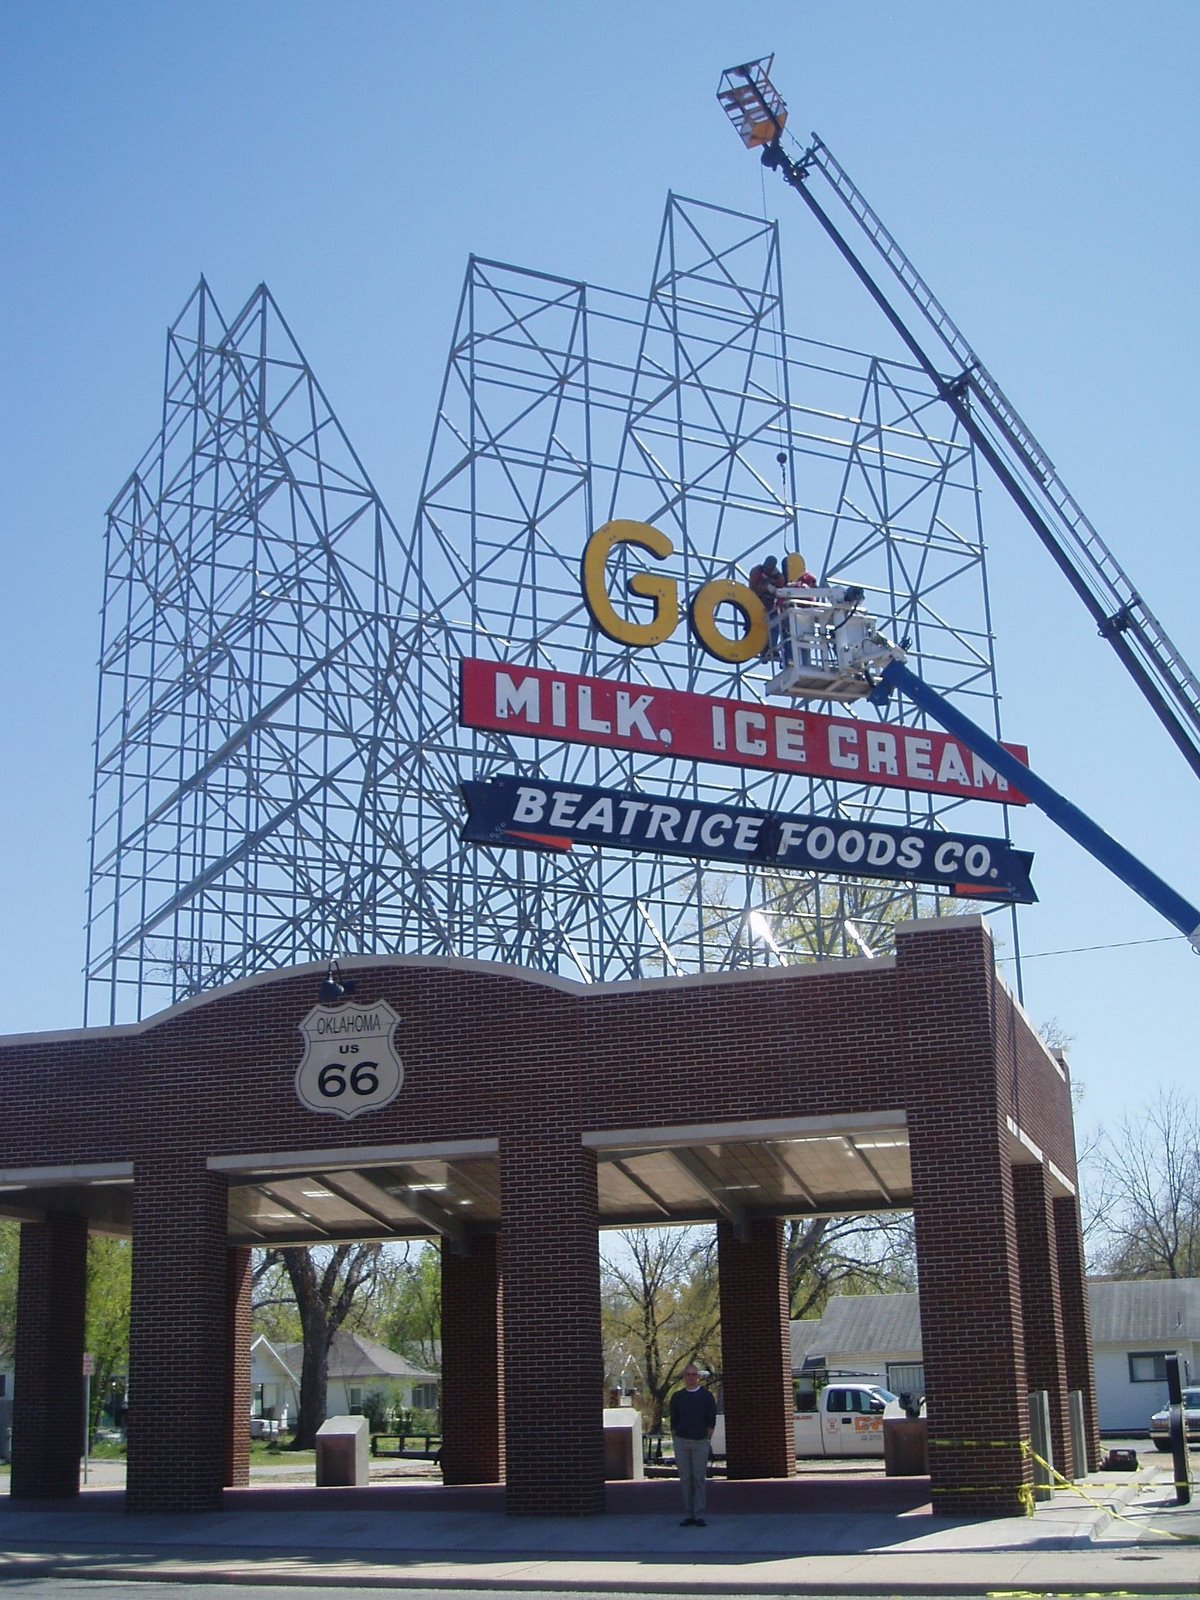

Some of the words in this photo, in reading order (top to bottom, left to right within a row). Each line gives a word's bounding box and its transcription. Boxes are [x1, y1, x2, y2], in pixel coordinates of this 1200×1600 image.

[712, 705, 807, 763] ICE
[827, 724, 1009, 791] CREAM
[512, 786, 765, 852] BEATRICE
[776, 821, 925, 870] FOODS
[934, 841, 999, 879] CO.
[317, 1014, 381, 1035] OKLAHOMA
[339, 1044, 360, 1054] US
[317, 1061, 380, 1098] 66
